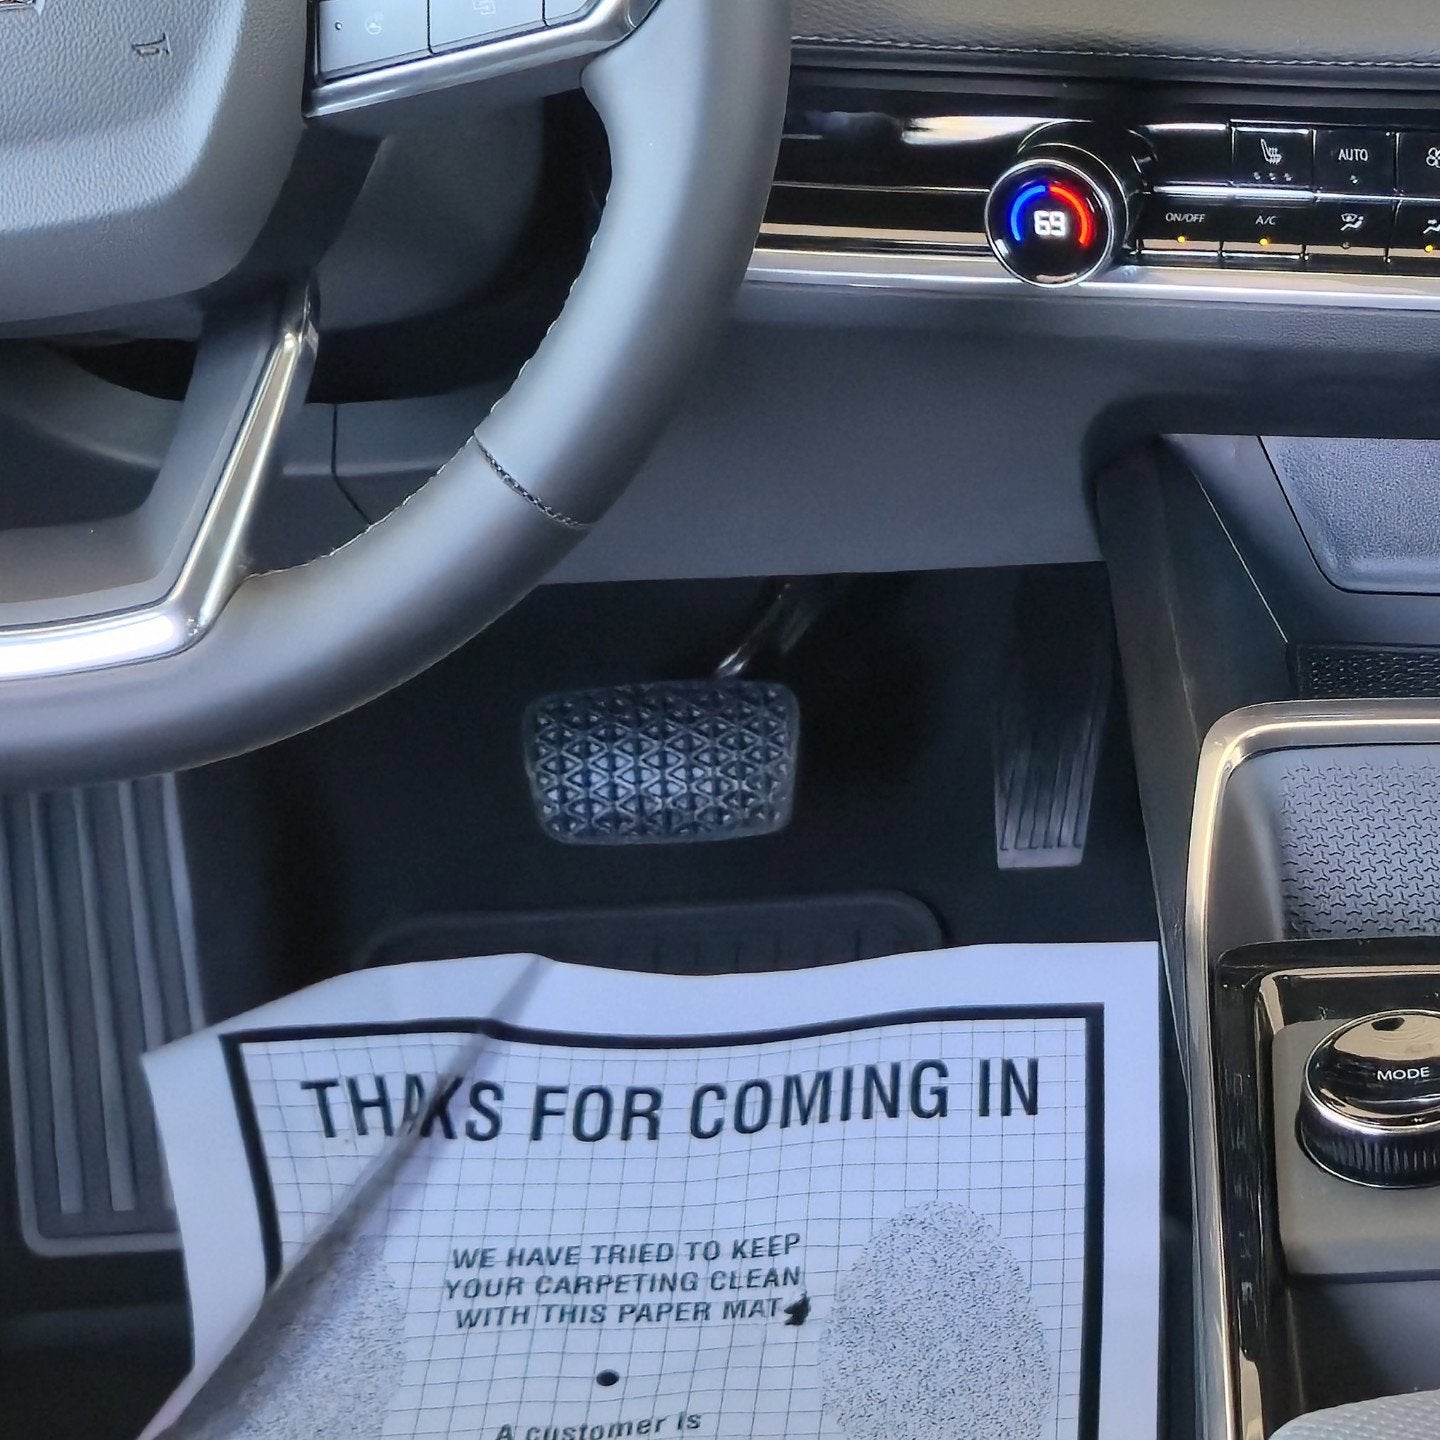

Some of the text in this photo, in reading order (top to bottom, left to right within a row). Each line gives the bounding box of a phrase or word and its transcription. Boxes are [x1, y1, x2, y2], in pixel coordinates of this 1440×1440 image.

[1338, 147, 1368, 163] AUTO
[1165, 211, 1206, 225] ON/OFF
[1255, 214, 1277, 227] A/C
[1377, 1066, 1430, 1080] MODE
[530, 1085, 662, 1142] FOR
[689, 1059, 950, 1139] COMING
[978, 1058, 1038, 1117] IN
[453, 1233, 801, 1269] WE HAVE TRIED TO KEEP
[445, 1266, 801, 1300] YOUR CARPETING CLEAN
[458, 1298, 783, 1328] WITH THIS PAPER MAT
[677, 1412, 701, 1430] is
